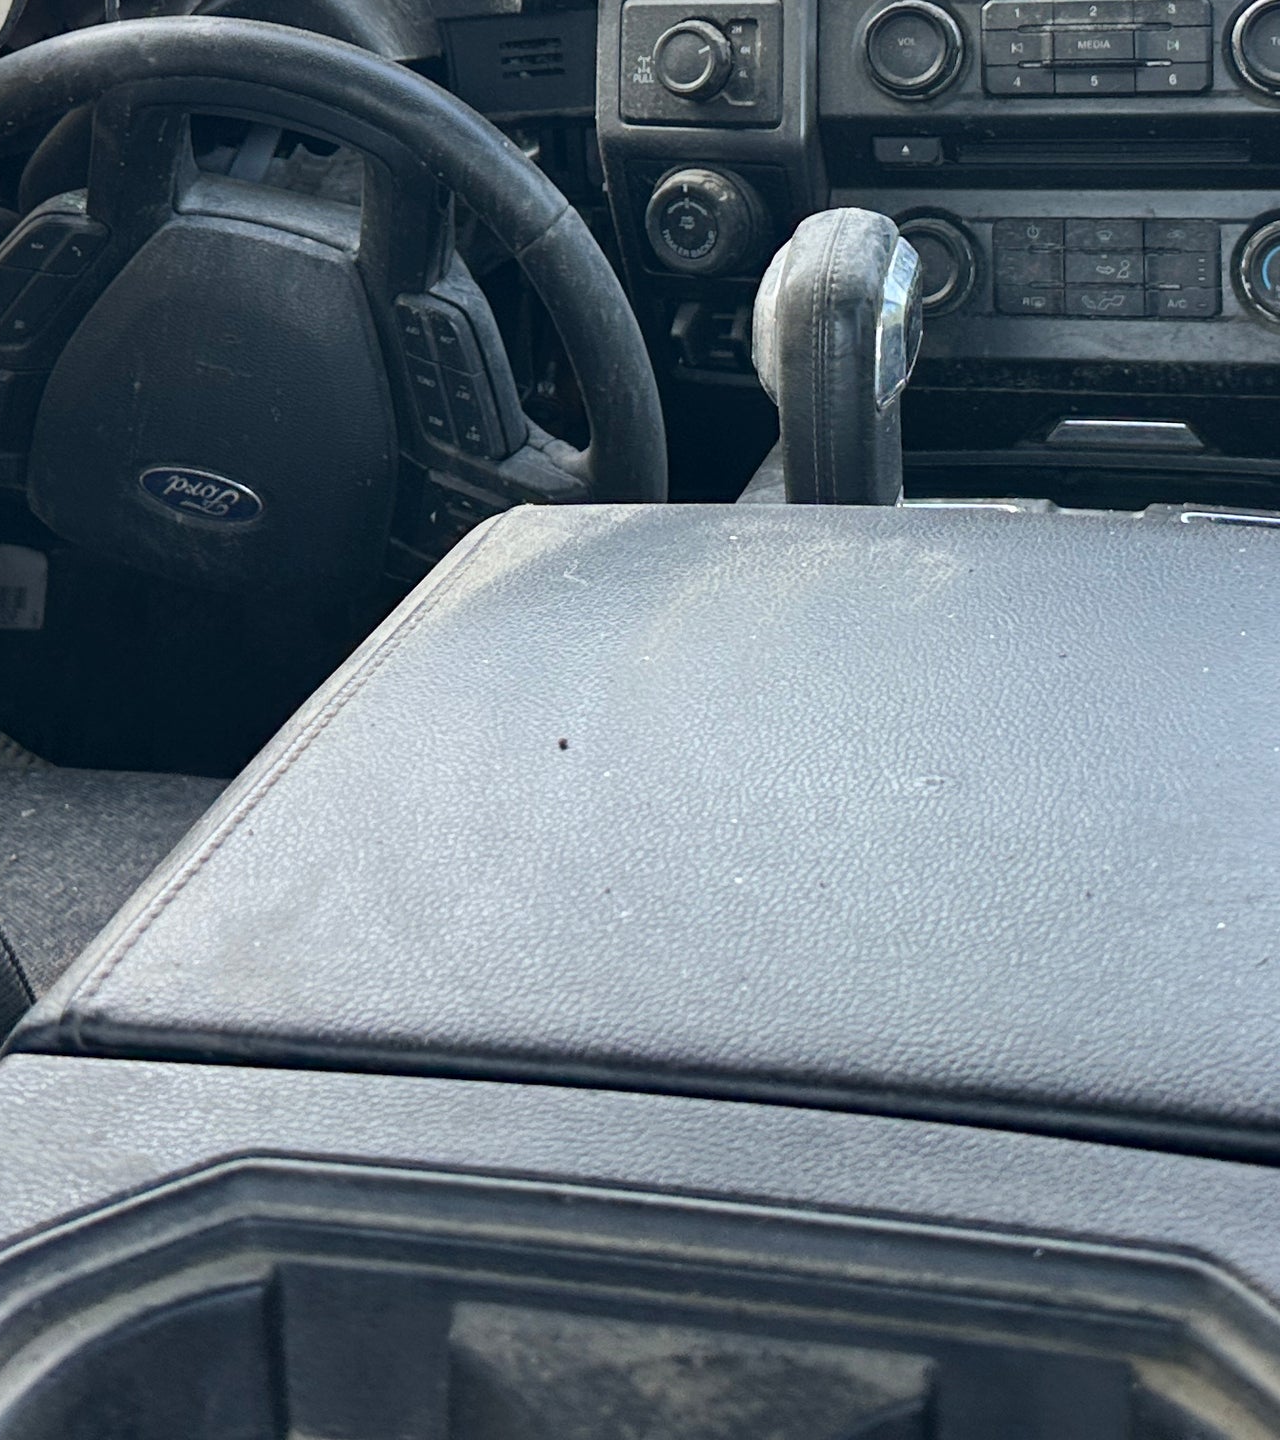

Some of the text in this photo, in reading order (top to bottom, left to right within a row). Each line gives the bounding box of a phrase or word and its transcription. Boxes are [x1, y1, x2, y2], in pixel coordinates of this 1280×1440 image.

[1014, 8, 1021, 18] 1
[1089, 6, 1098, 17] 2
[1167, 4, 1176, 14] 3
[897, 37, 915, 47] VOL
[1077, 40, 1111, 50] MEDIA
[633, 73, 654, 84] PULL
[1013, 76, 1021, 87] 4
[1090, 76, 1098, 86] 5
[1169, 74, 1177, 85] 6
[1167, 298, 1188, 308] A/C
[163, 475, 239, 516] Ford
